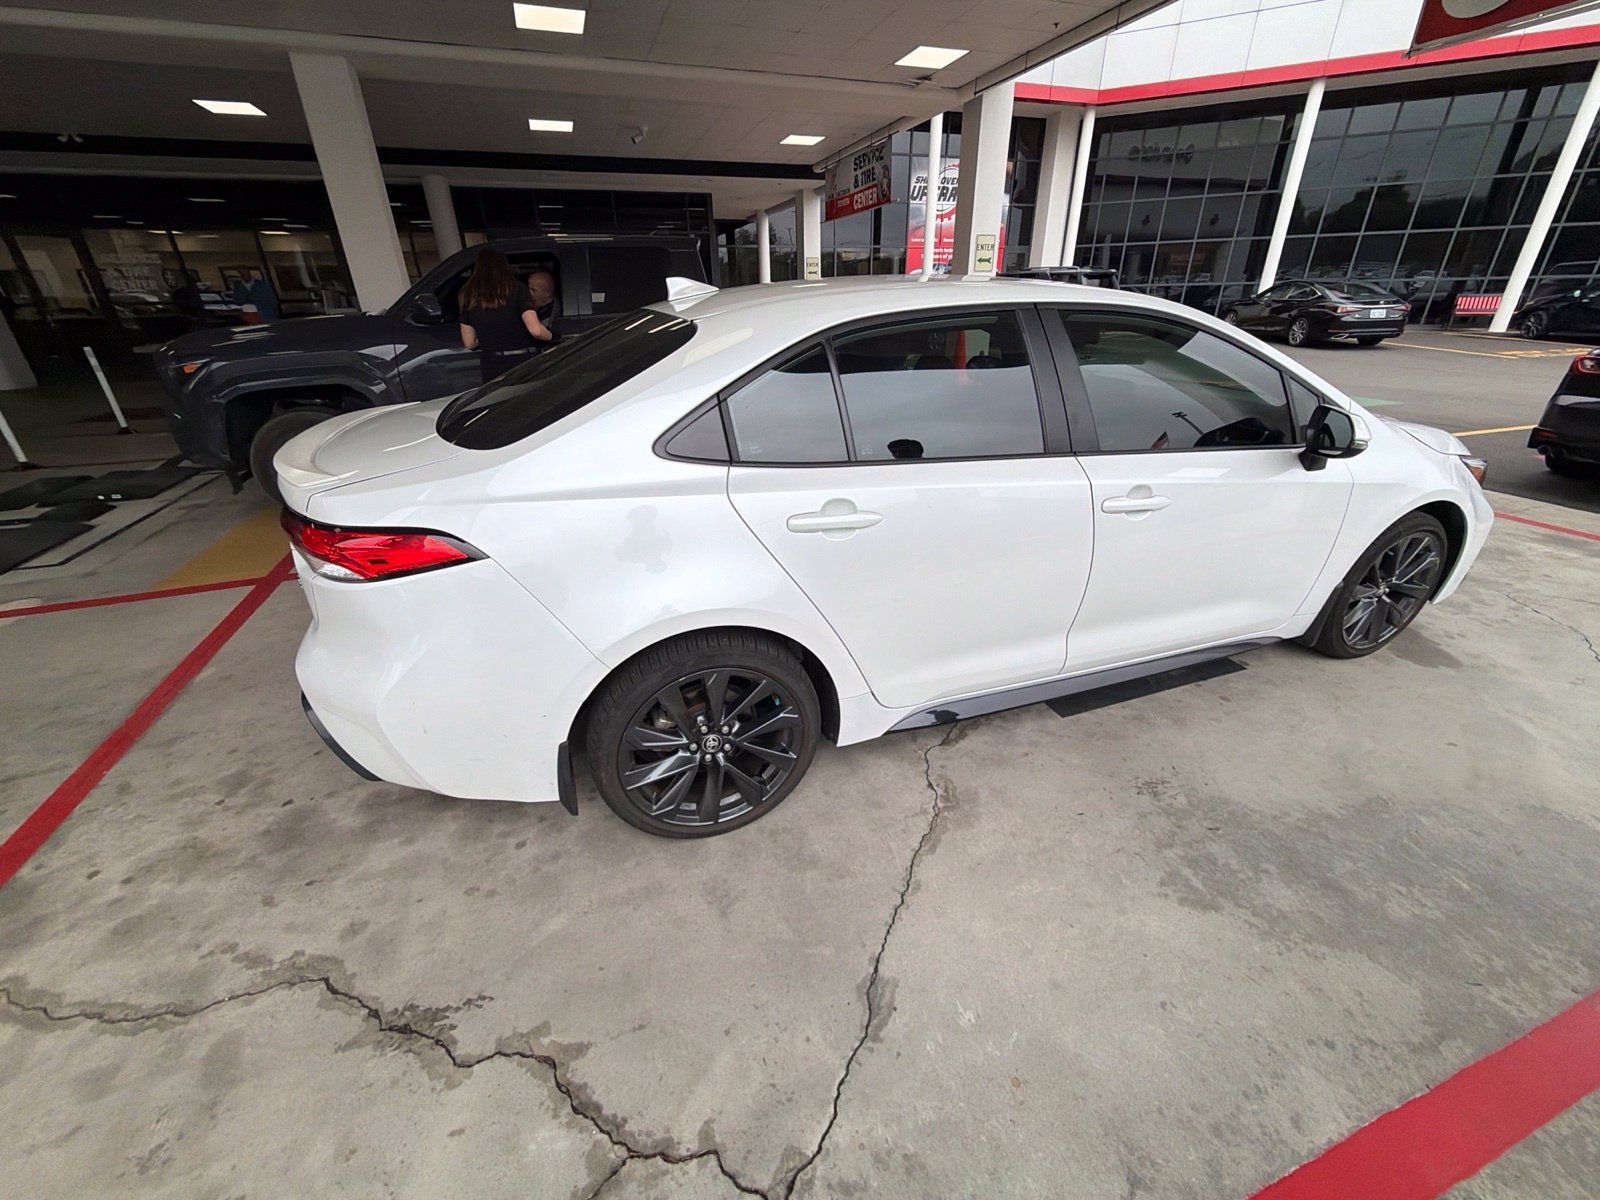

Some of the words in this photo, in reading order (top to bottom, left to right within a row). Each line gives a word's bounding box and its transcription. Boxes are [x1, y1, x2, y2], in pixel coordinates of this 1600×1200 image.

[853, 145, 885, 172] SERVICE
[853, 174, 859, 189] &
[861, 166, 876, 187] TIRE
[853, 187, 878, 210] CENTER
[976, 243, 995, 251] ENTER
